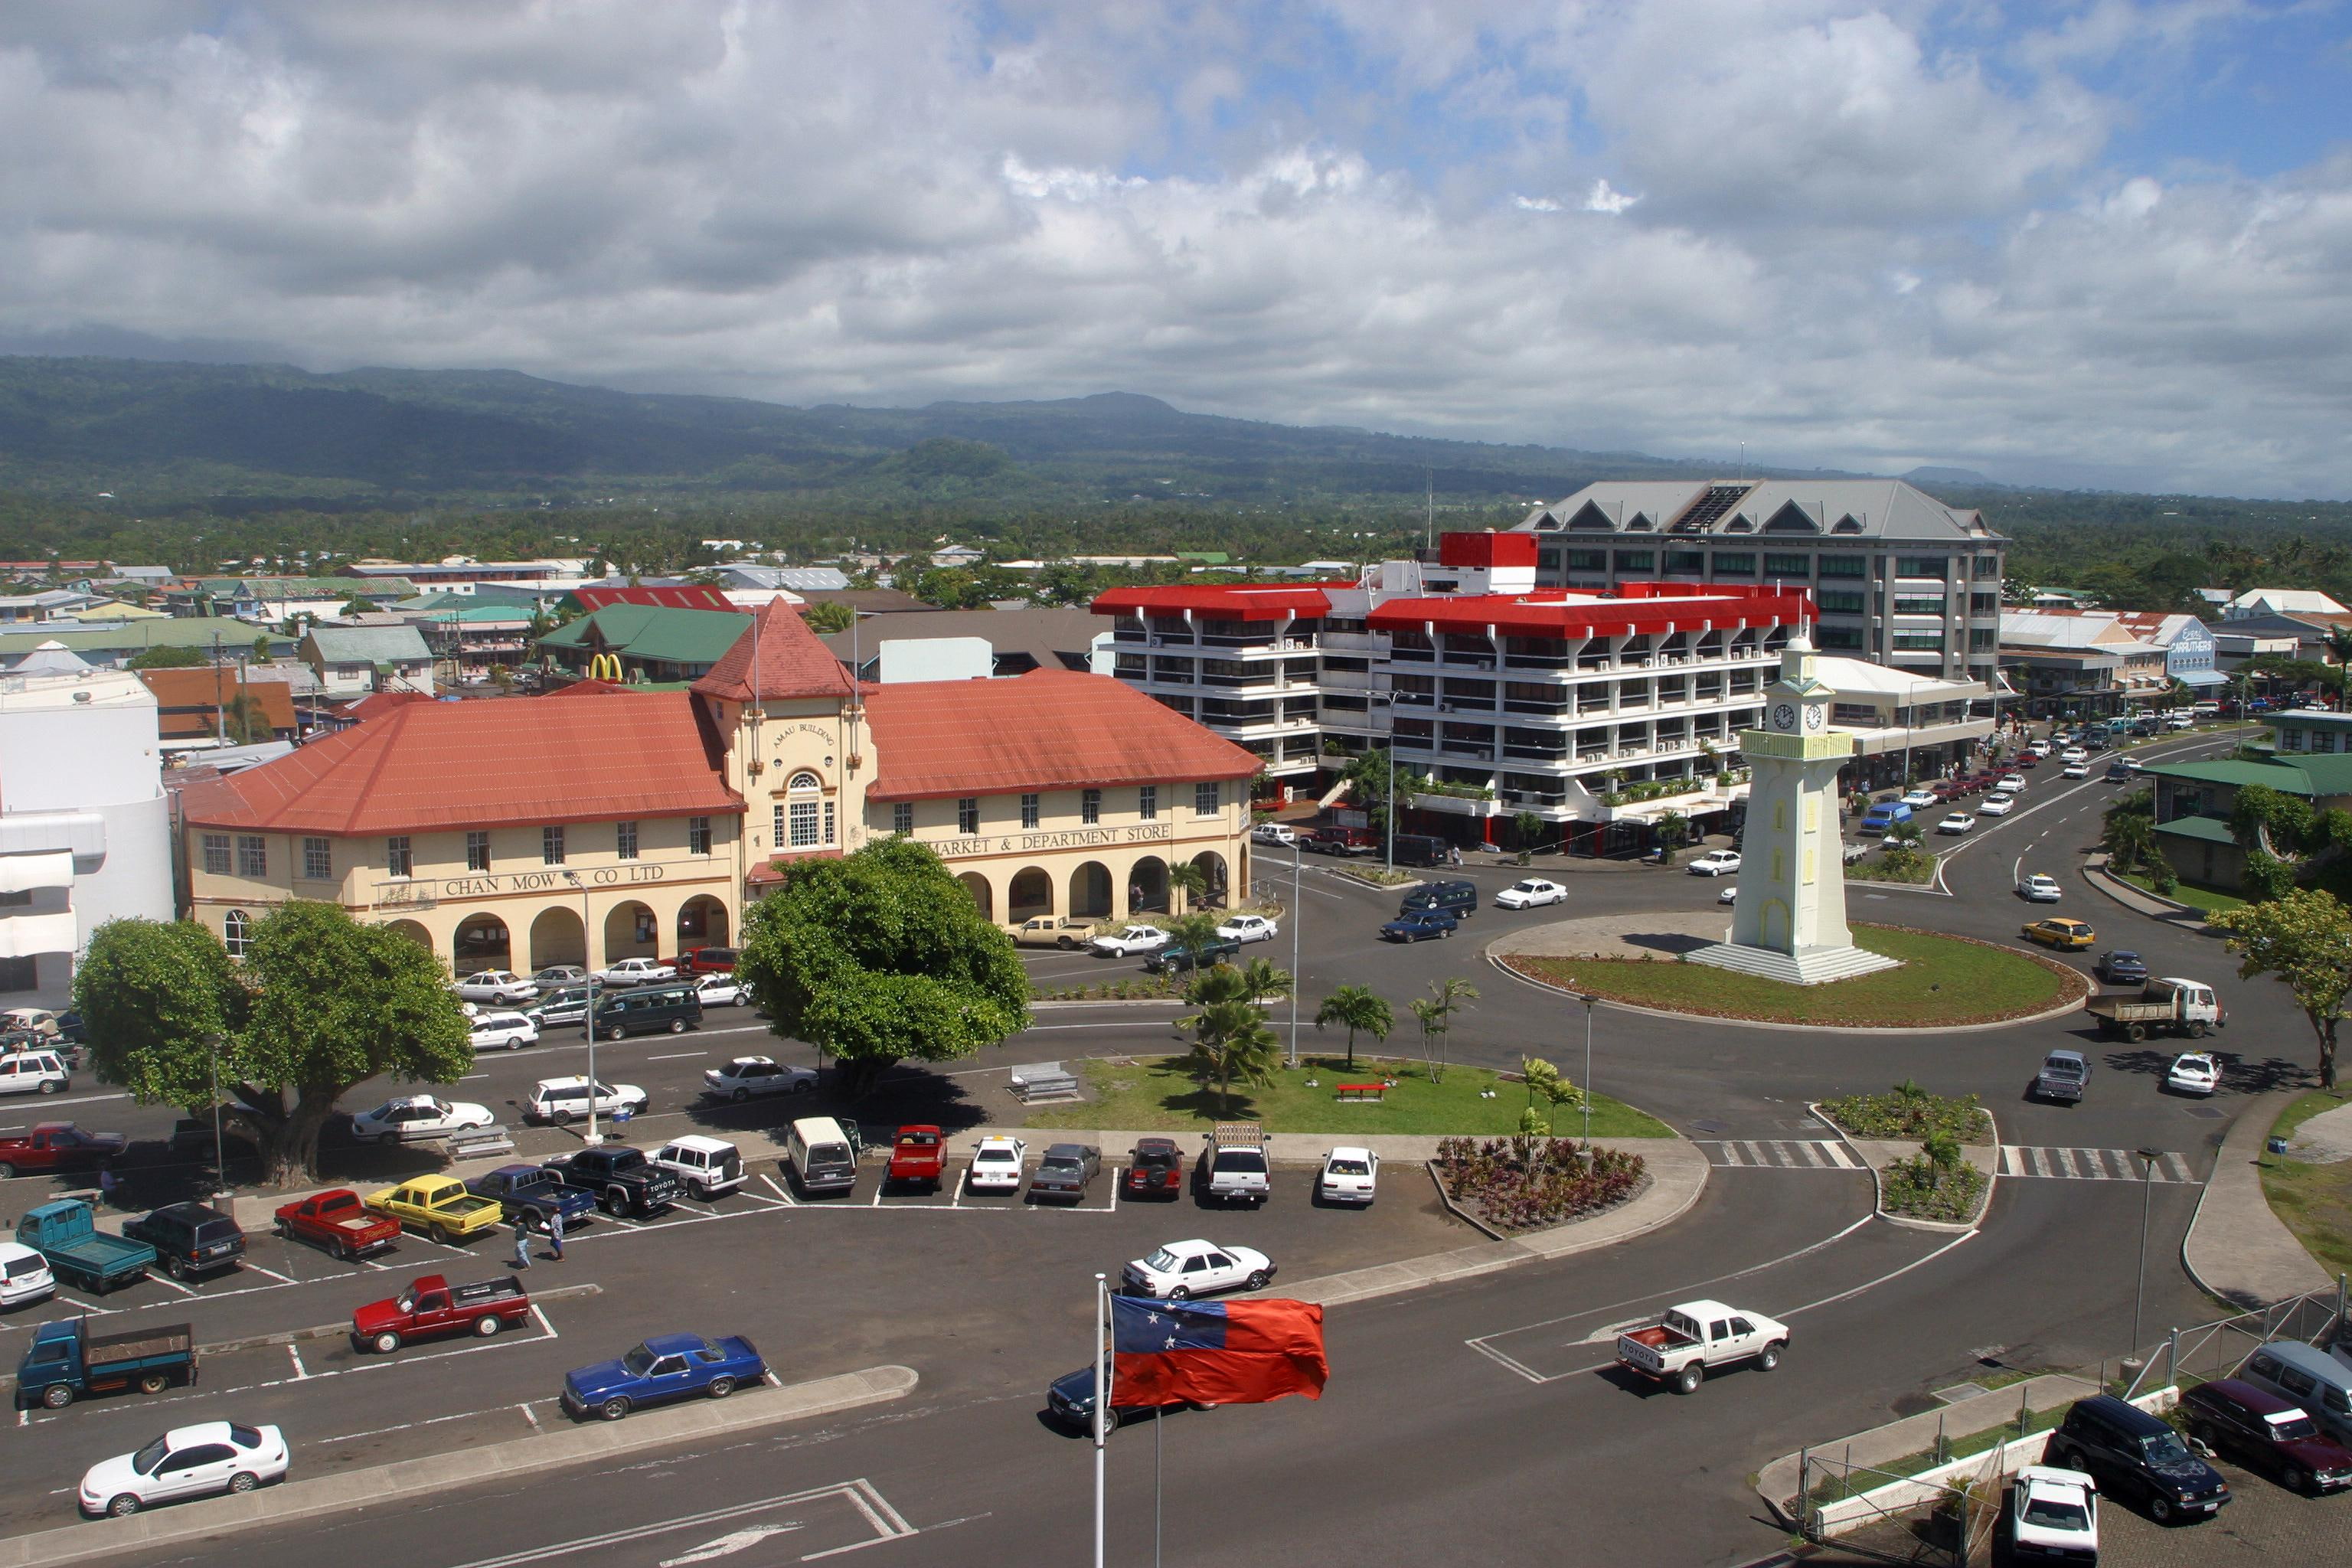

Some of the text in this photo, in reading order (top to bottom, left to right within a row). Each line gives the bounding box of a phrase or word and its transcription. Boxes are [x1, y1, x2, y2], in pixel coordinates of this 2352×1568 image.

[799, 724, 835, 746] BUILDING
[1000, 838, 1011, 851] &
[1022, 829, 1119, 850] DEPARTMENT
[1127, 825, 1170, 841] STORE
[446, 877, 499, 896] CHAN
[511, 873, 557, 890] MOW
[593, 869, 618, 884] CO
[629, 865, 664, 881] LTD
[650, 1179, 675, 1193] TOYOTA
[1624, 1344, 1654, 1364] TOYOTA
